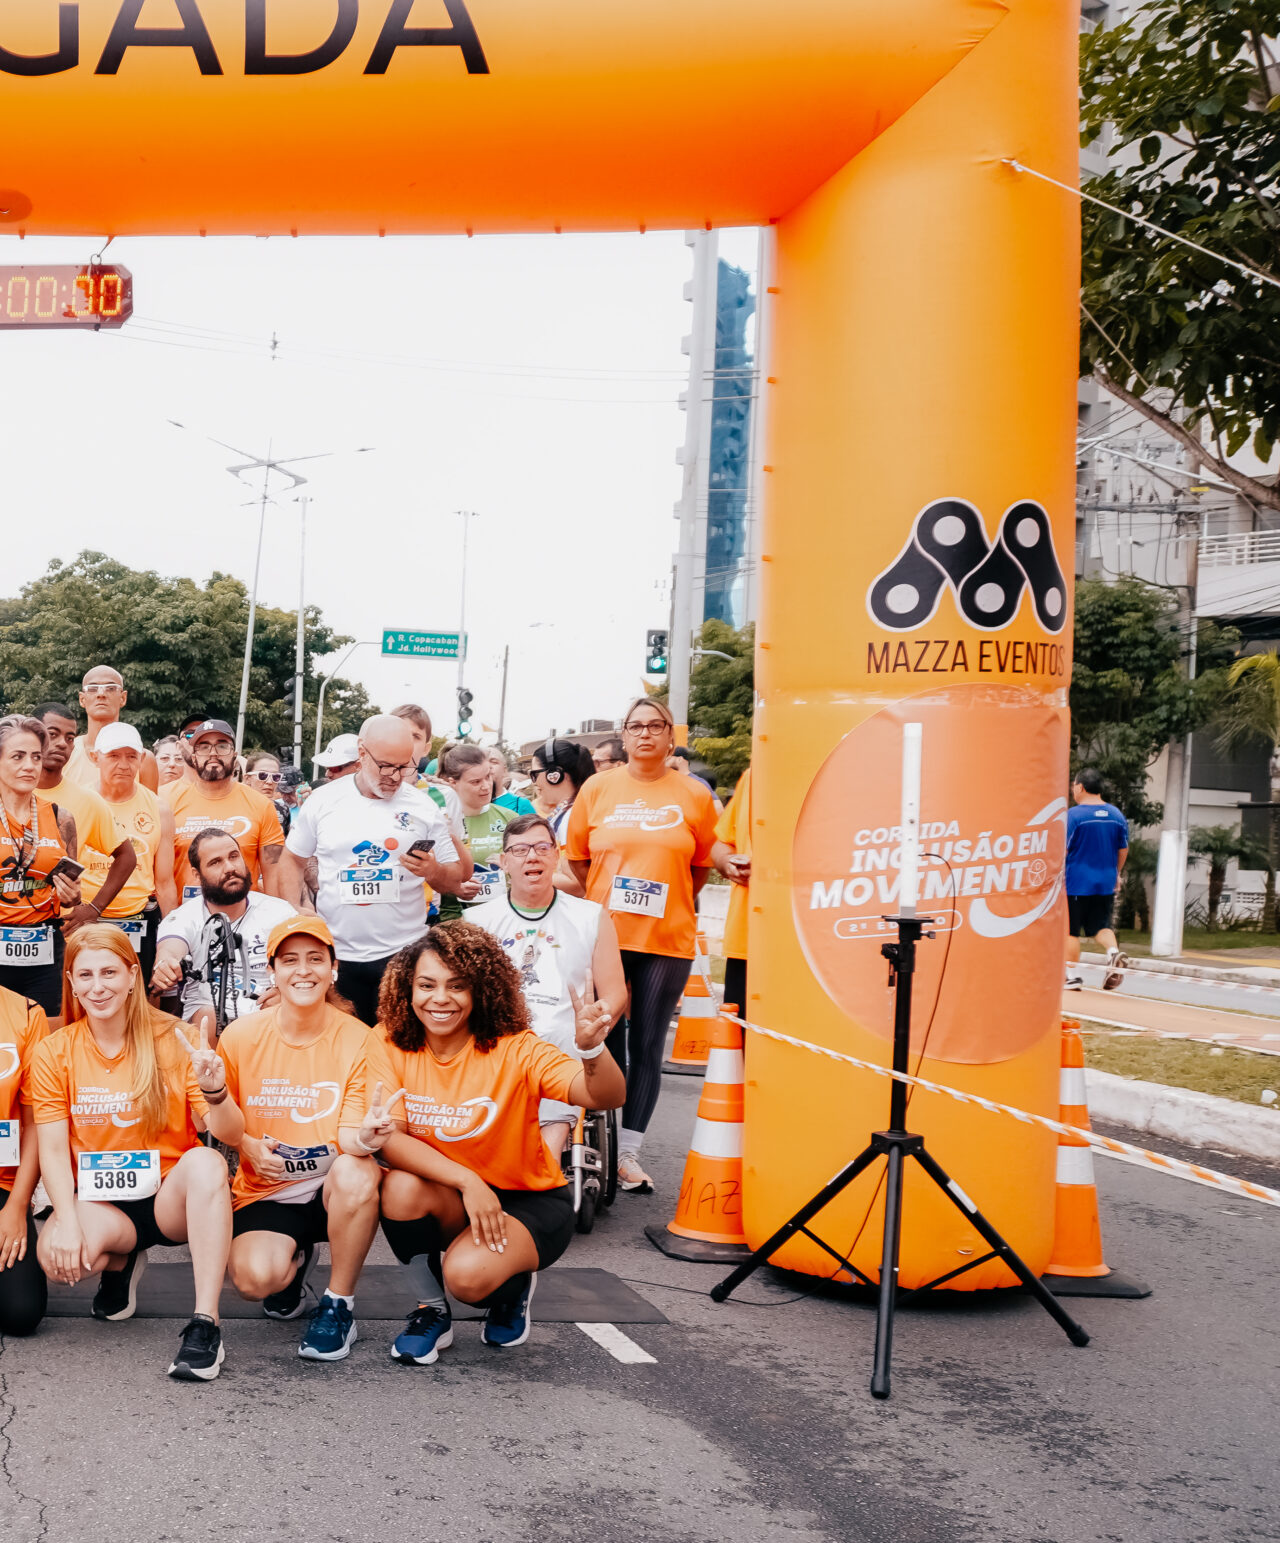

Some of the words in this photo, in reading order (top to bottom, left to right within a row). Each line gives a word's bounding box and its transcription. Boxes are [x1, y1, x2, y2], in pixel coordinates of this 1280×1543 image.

[409, 635, 458, 645] Copacaban
[867, 640, 969, 674] MAZZA
[978, 640, 1065, 676] EVENTOS
[854, 820, 960, 846] CORIDA
[1017, 830, 1049, 856] EM
[352, 882, 380, 896] 6131
[624, 891, 649, 906] 5371
[6, 943, 39, 957] 6005
[76, 1091, 128, 1103] INCLUSÃO
[260, 1085, 307, 1096] INCLUSÃO
[405, 1101, 455, 1115] NCLUSÃO
[456, 1107, 473, 1116] EM
[284, 1159, 318, 1173] 048
[94, 1170, 137, 1189] 5389
